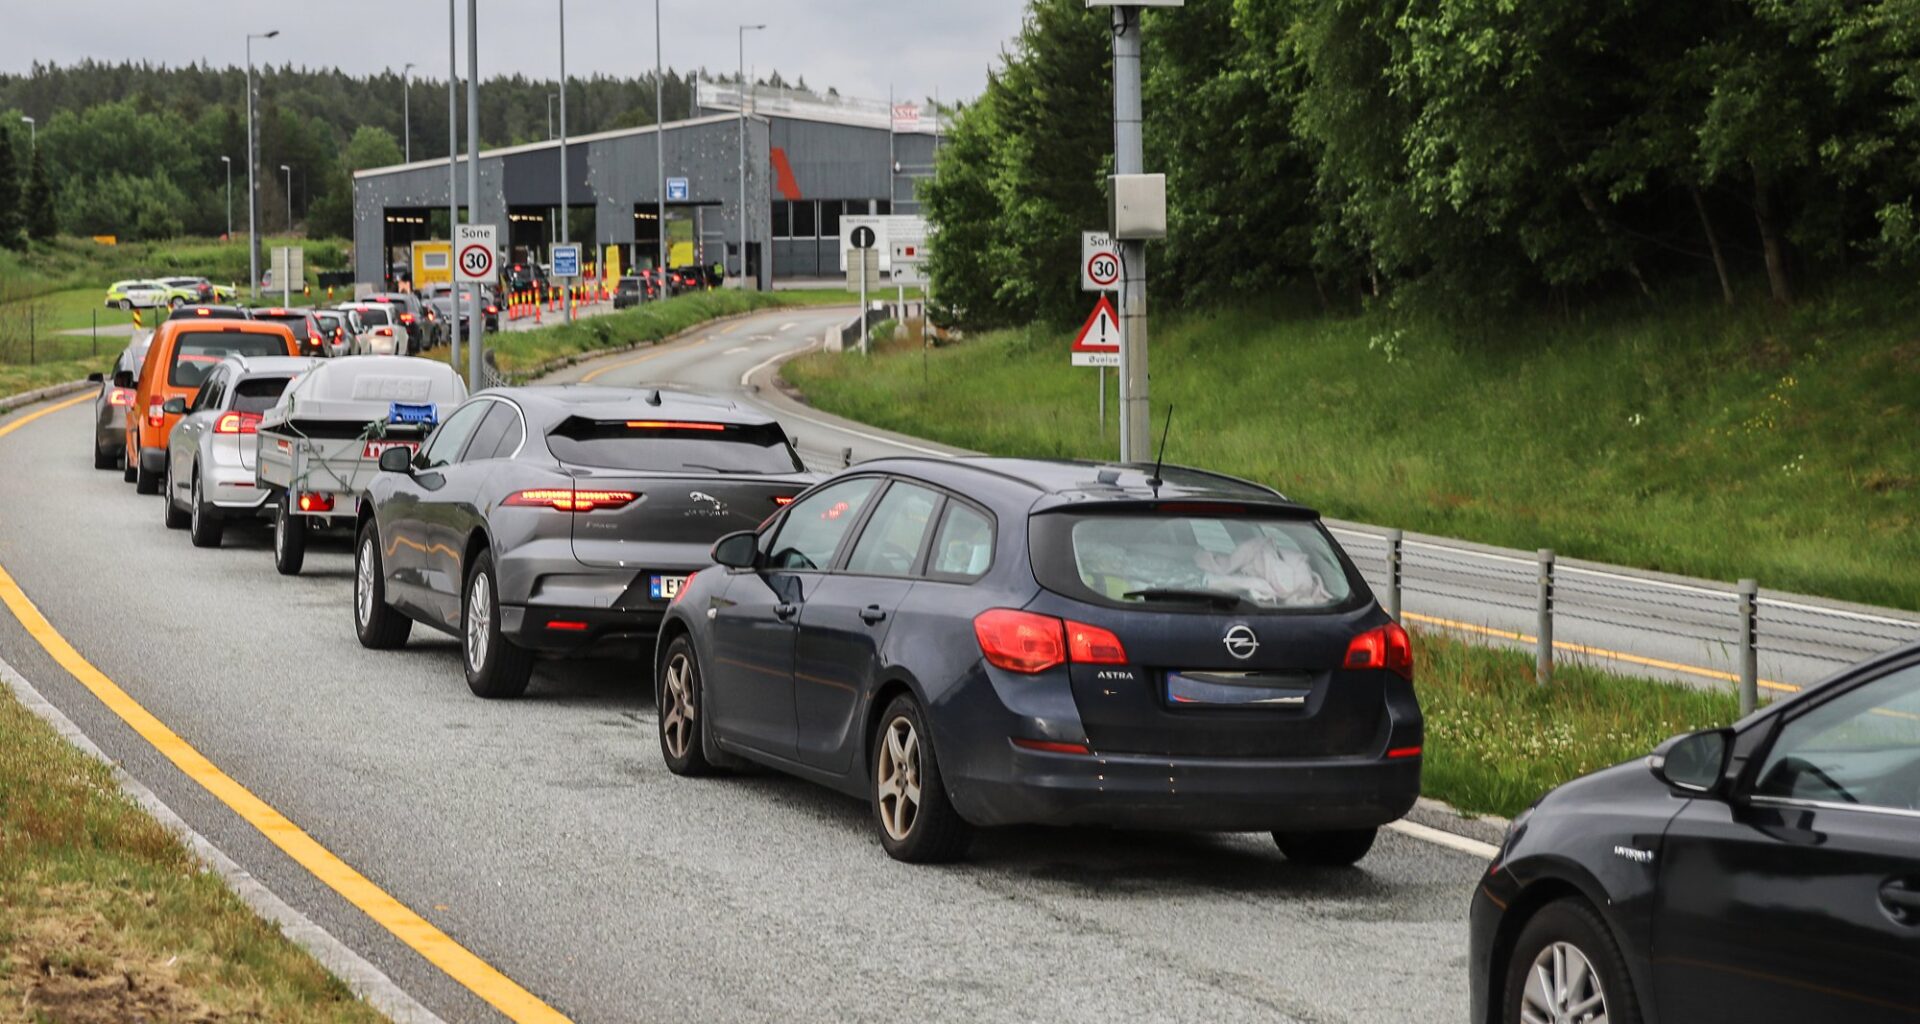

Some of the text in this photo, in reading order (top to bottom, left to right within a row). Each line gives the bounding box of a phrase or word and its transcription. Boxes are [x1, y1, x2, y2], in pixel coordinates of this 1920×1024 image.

[462, 227, 490, 239] Sone
[1090, 235, 1114, 247] Son
[466, 252, 487, 269] 30
[1094, 260, 1115, 277] 30
[1098, 671, 1134, 680] ASTRA
